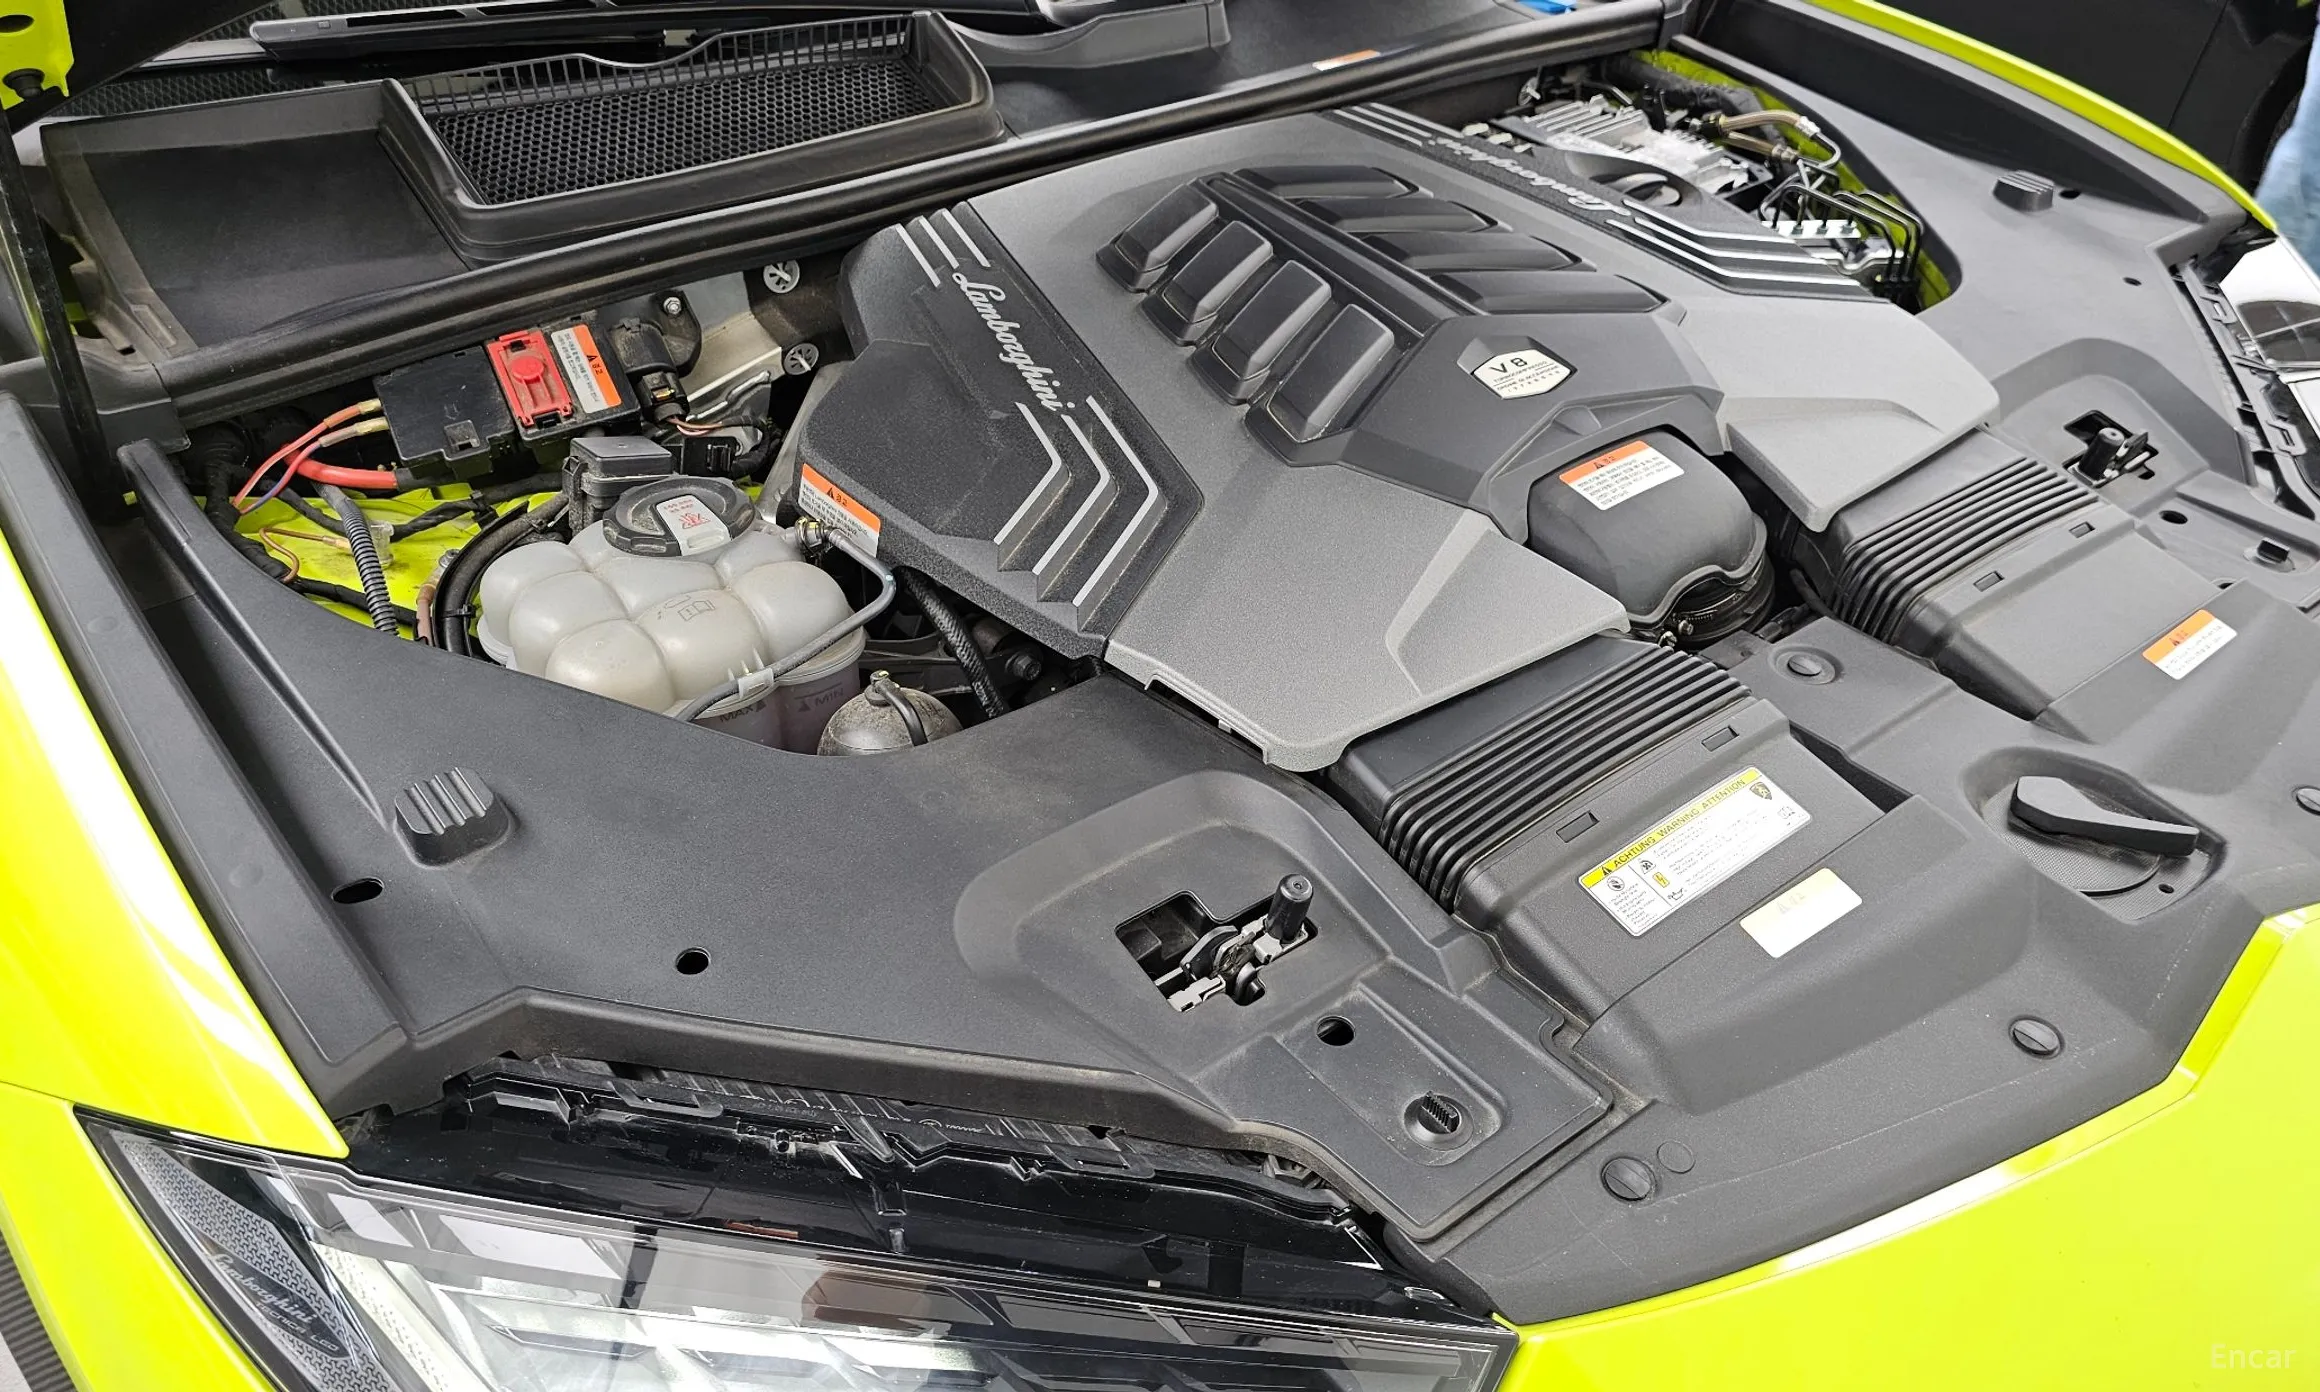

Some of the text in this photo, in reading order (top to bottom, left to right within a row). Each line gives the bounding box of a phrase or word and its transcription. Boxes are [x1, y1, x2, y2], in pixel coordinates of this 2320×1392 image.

[1428, 137, 1631, 216] Lamborghini
[952, 272, 1075, 411] Lamborghini
[815, 688, 844, 706] MIN
[1613, 836, 1656, 868] ACHTUNG
[1658, 808, 1700, 837] WARNING
[1701, 778, 1746, 810] ATTENTION
[207, 1253, 318, 1324] Lamborghini
[311, 1335, 338, 1350] LED
